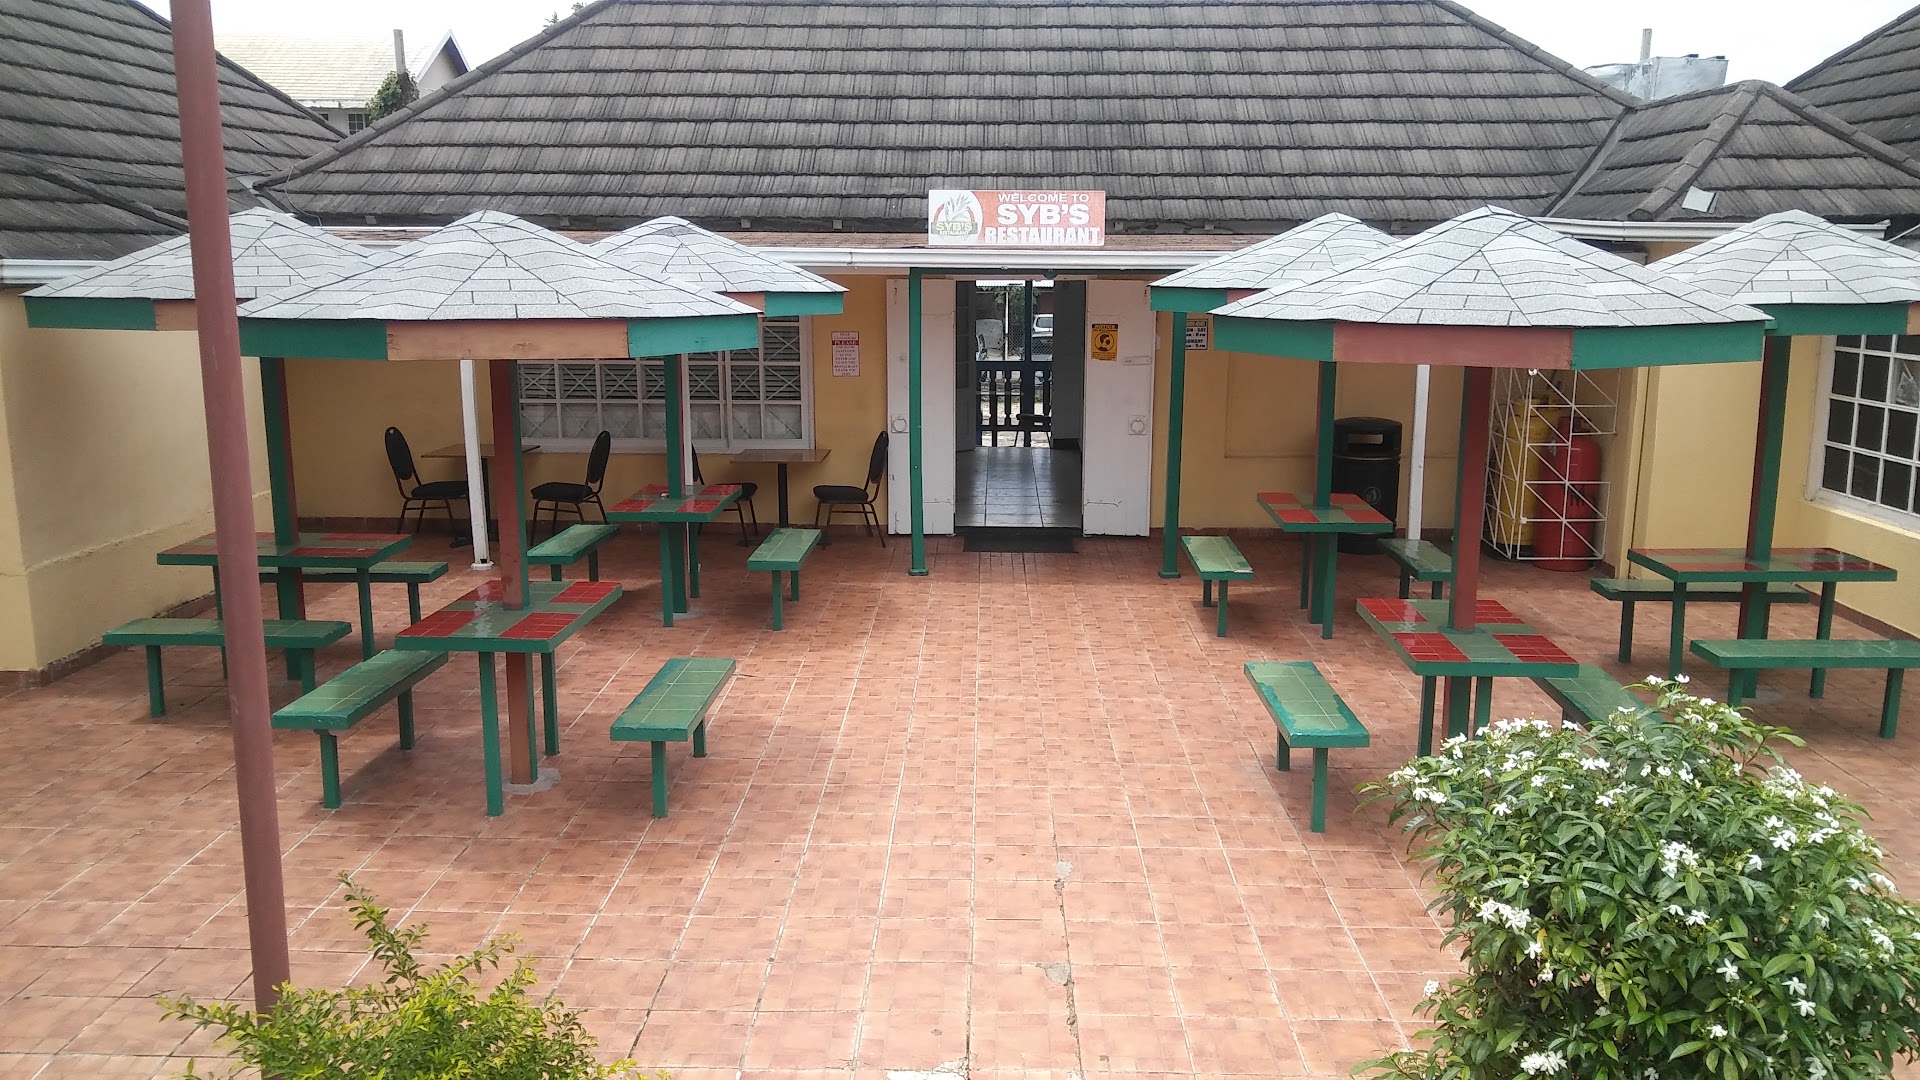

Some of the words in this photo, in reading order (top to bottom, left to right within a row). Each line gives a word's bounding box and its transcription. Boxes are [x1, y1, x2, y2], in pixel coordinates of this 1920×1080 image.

[998, 193, 1069, 202] WELCOME
[1071, 193, 1090, 202] TO
[997, 203, 1090, 225] SYB'S
[936, 222, 972, 231] SYB'S
[984, 226, 1101, 244] RESTAURANT
